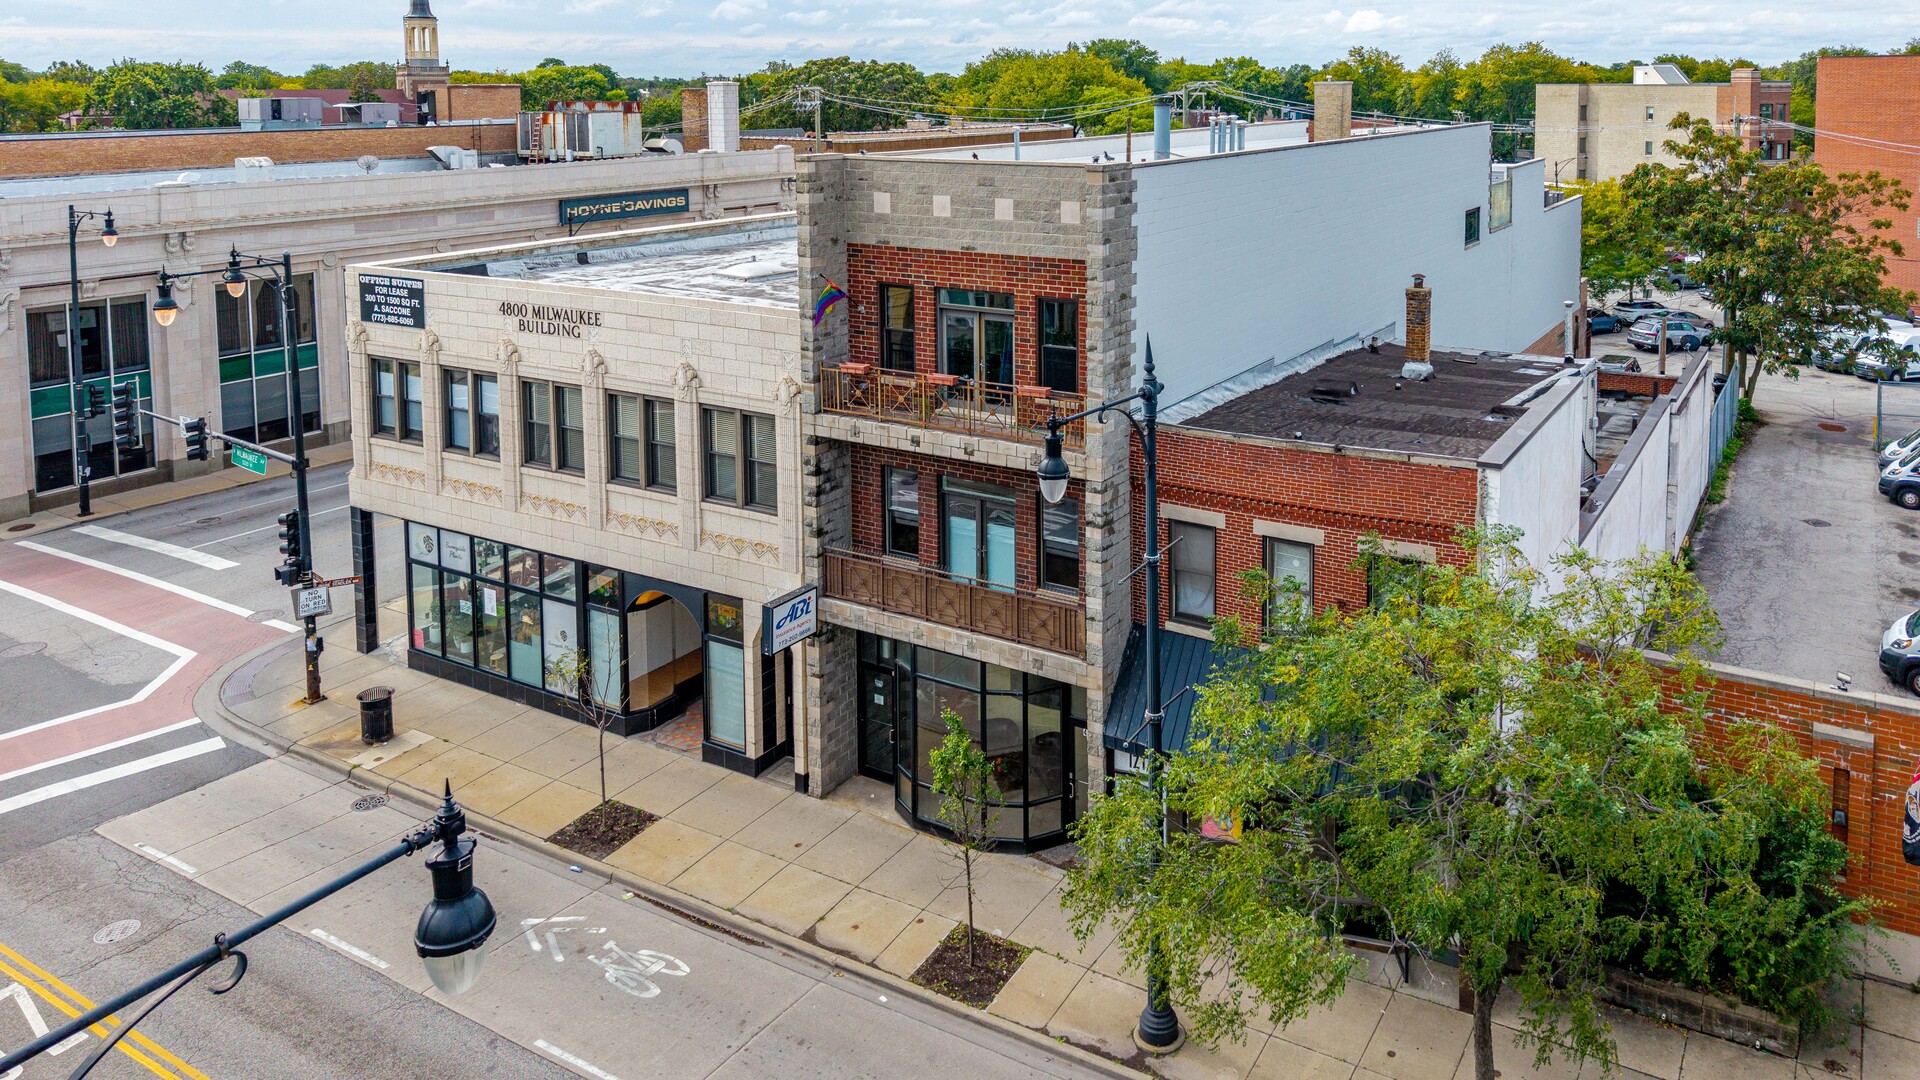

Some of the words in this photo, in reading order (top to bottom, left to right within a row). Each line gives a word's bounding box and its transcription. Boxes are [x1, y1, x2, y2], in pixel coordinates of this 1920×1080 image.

[567, 203, 621, 218] HOYNE
[625, 196, 686, 212] SAVINGS
[360, 275, 390, 286] OFFICE
[391, 278, 423, 289] SUITES
[375, 286, 388, 295] FOR
[389, 287, 409, 297] LEASE
[365, 294, 376, 302] 300
[377, 295, 386, 303] TO
[387, 296, 401, 306] 1500
[401, 298, 411, 307] SQ
[374, 304, 380, 312] A.
[381, 305, 411, 316] SACCONE
[499, 301, 528, 318] 4800
[532, 305, 602, 327] MILWAUKEE
[371, 313, 414, 326] (773)-685-6060
[518, 319, 581, 338] BUILDING
